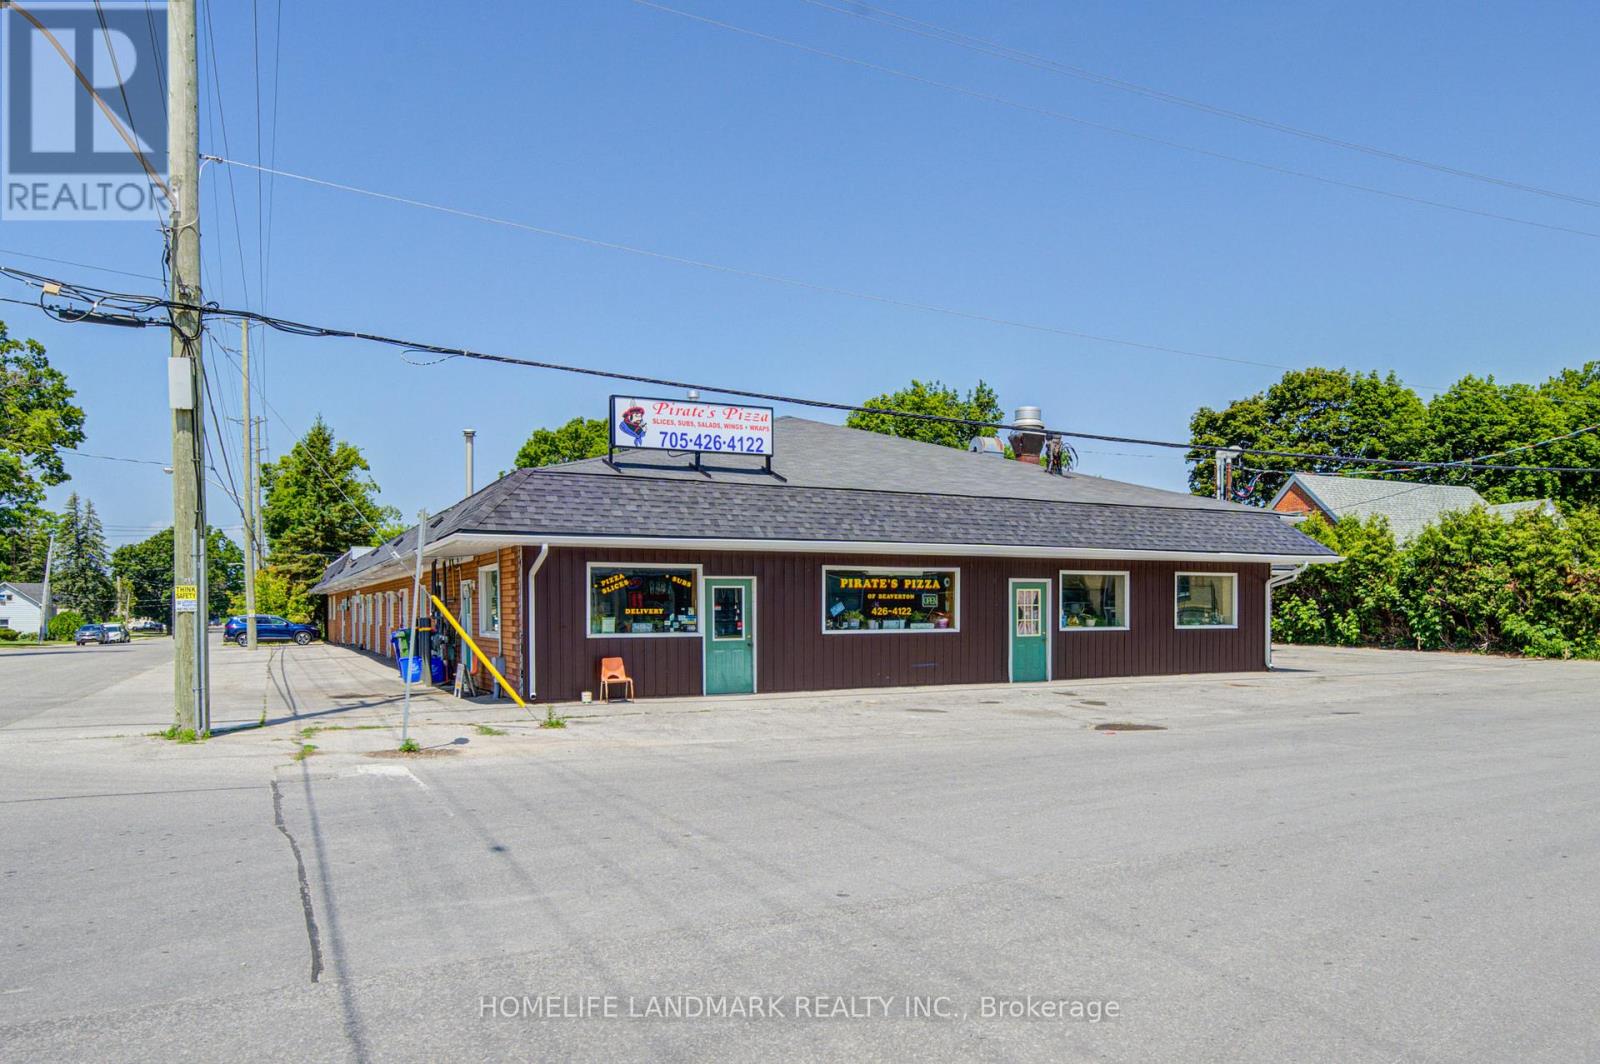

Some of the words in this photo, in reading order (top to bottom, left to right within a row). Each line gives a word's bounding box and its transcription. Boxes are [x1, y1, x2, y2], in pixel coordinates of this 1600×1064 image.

[652, 401, 716, 418] Pirate's
[722, 407, 769, 423] Pizza
[652, 418, 676, 426] SLICES,
[677, 419, 697, 428] SUBS,
[697, 421, 723, 430] SALADS,
[600, 573, 626, 587] PIZZA
[671, 575, 693, 588] SUBS
[840, 577, 899, 589] PIRATE'S
[904, 579, 941, 589] PIZZA
[601, 579, 630, 595] SLICES
[871, 606, 912, 616] 426-4122
